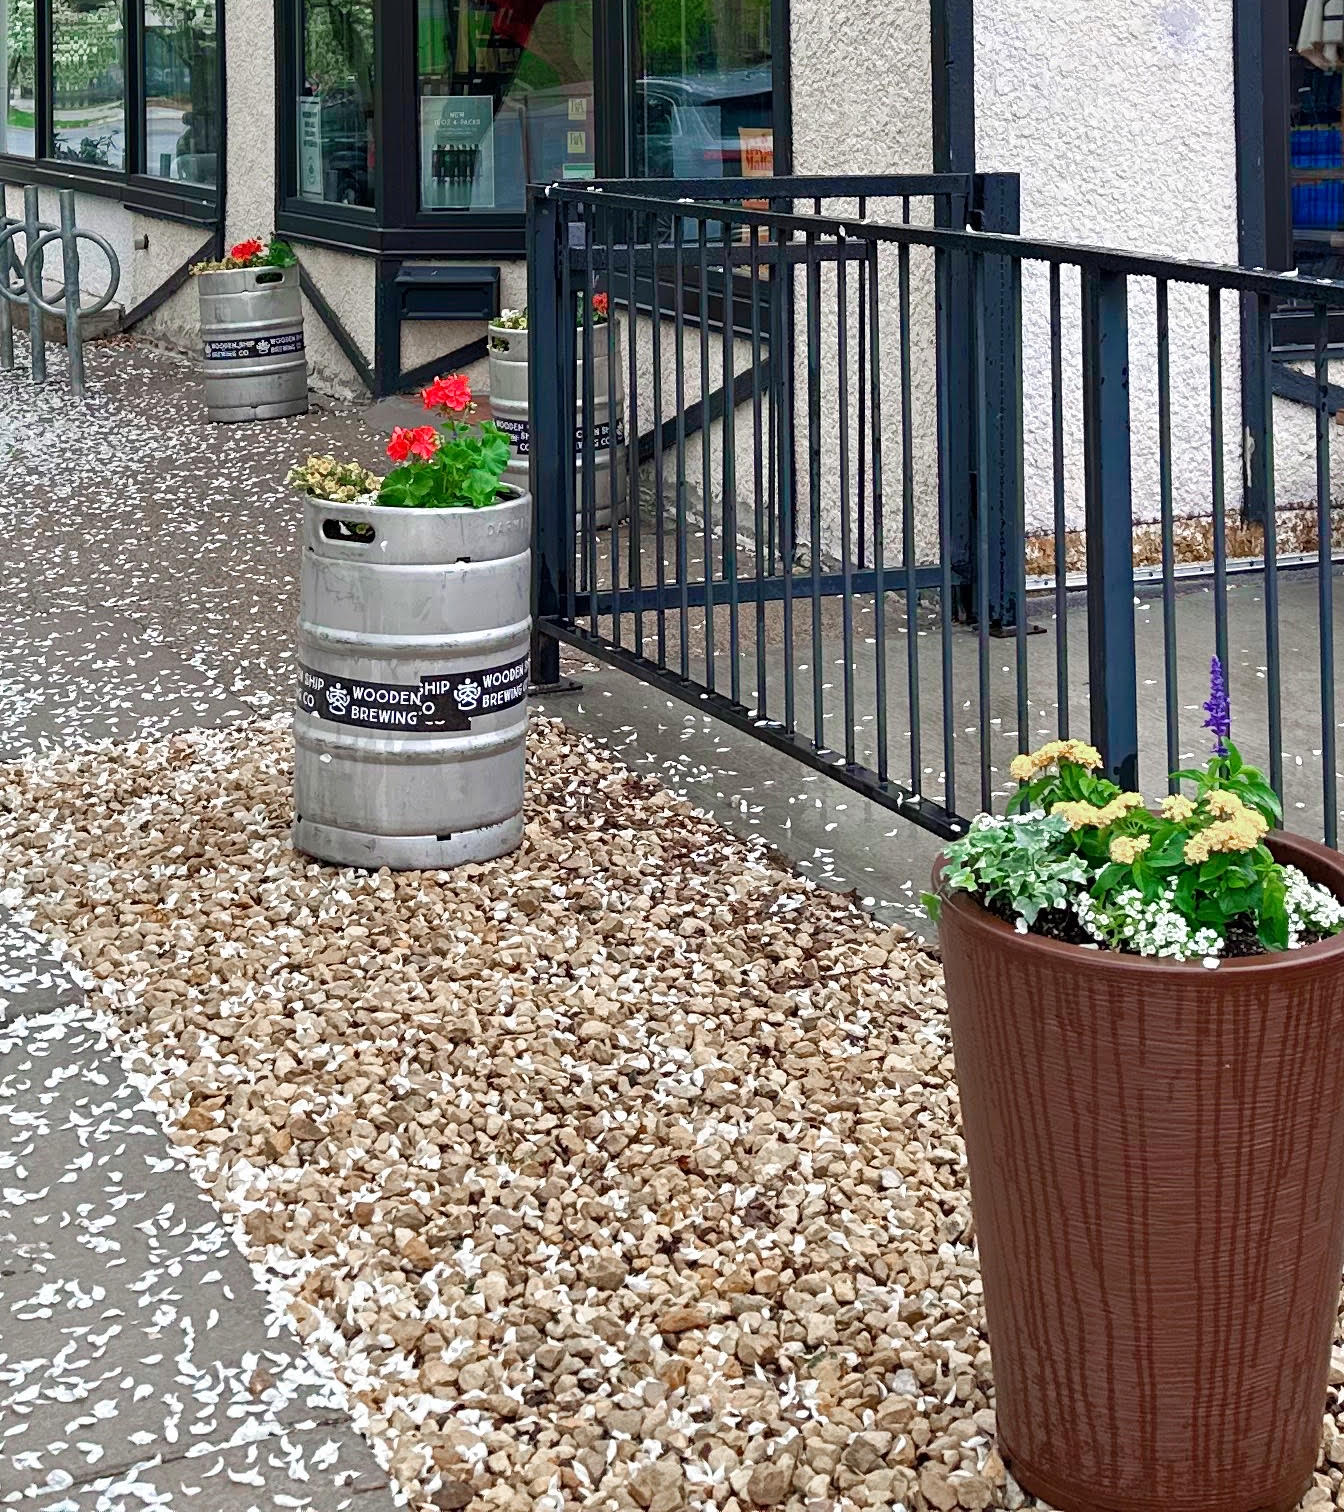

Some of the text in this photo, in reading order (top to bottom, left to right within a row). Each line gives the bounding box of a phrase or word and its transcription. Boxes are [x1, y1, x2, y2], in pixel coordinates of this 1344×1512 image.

[238, 349, 249, 357] CO
[304, 672, 325, 691] SHIP
[482, 664, 524, 689] WOODEN
[302, 691, 315, 707] CO
[352, 685, 421, 706] WOODEN
[481, 683, 523, 708] BREWING
[351, 705, 417, 725] BREWING
